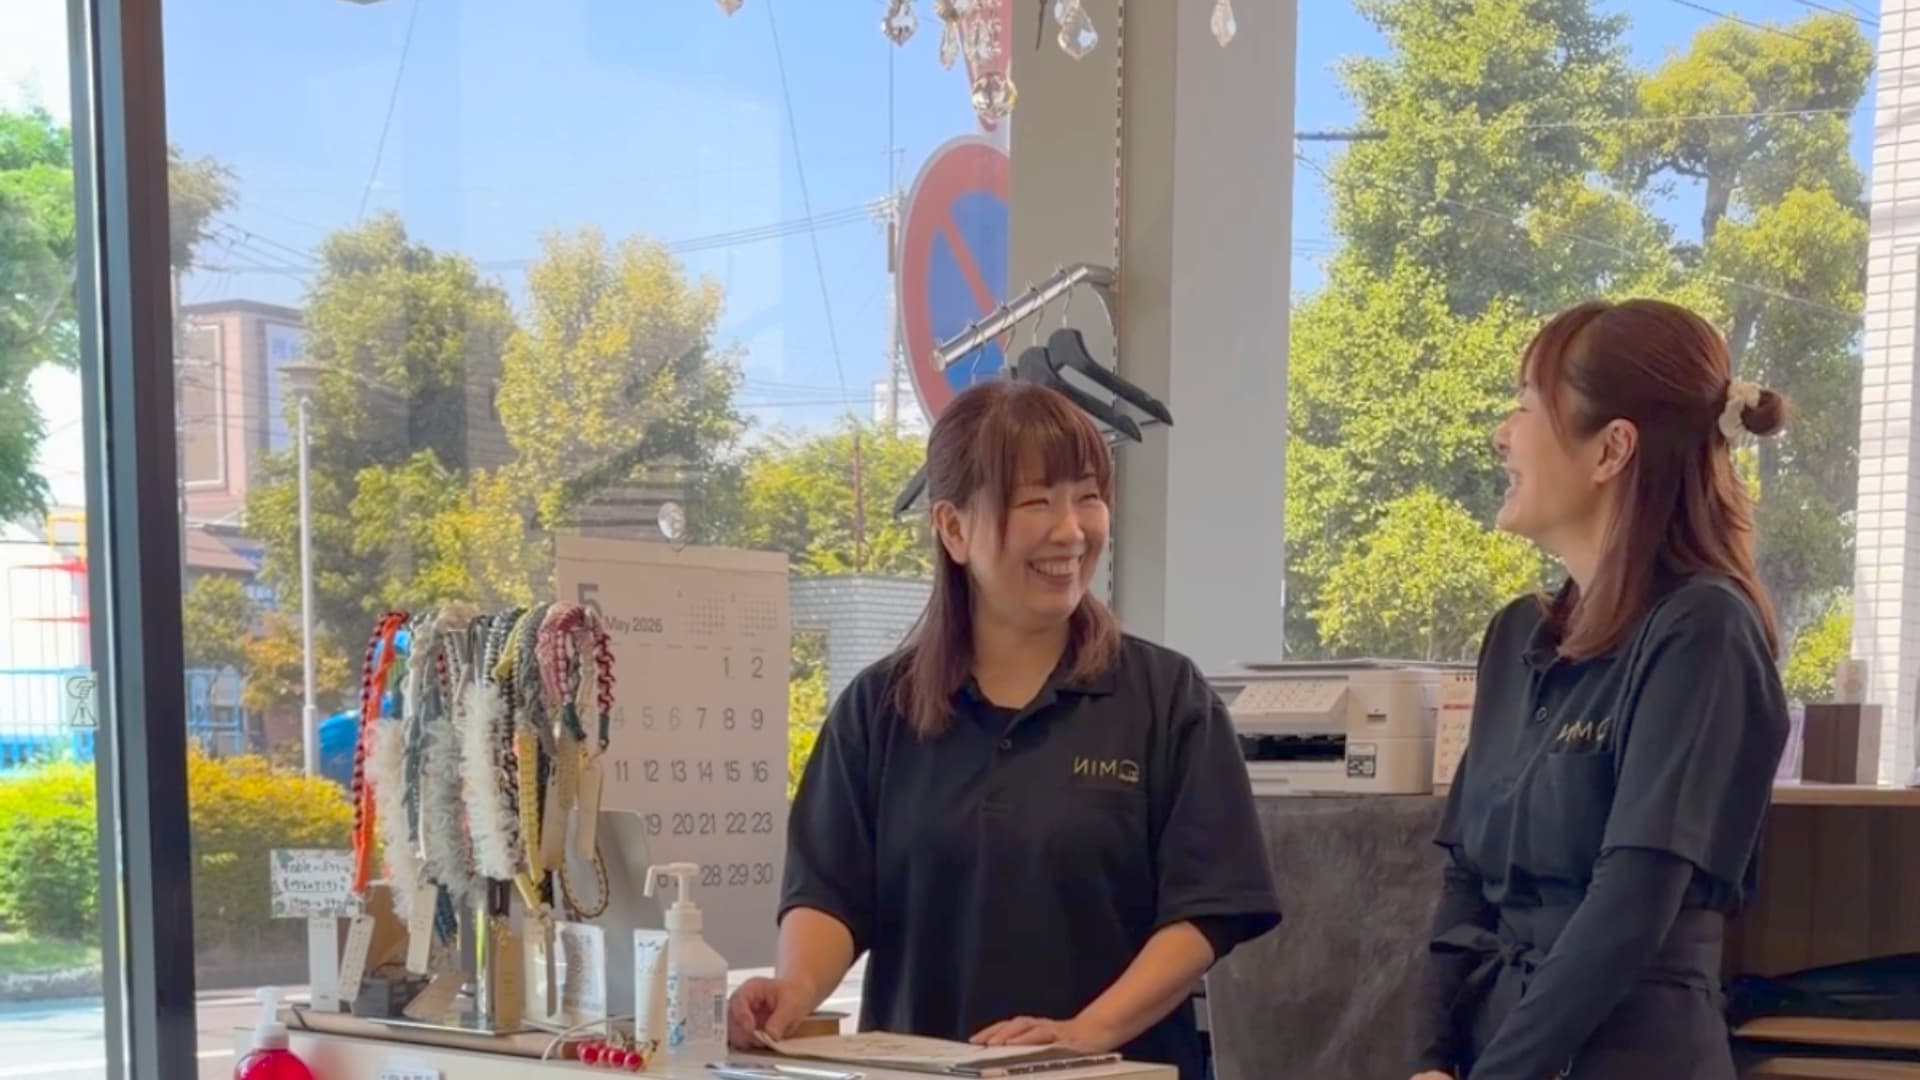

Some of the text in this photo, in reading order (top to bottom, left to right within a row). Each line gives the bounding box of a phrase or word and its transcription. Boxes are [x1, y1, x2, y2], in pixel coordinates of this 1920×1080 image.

[605, 616, 663, 634] May 2026
[723, 656, 764, 679] 1 2
[642, 705, 655, 729] 5
[669, 707, 681, 730] 6
[696, 708, 707, 729] 7
[723, 708, 735, 730] 8
[751, 708, 763, 730] 9
[615, 760, 769, 783] 11 12 13 14 15 16
[646, 812, 773, 836] 19 20 21 22 23
[701, 865, 722, 887] 28
[727, 864, 749, 886] 29
[752, 863, 773, 886] 30
